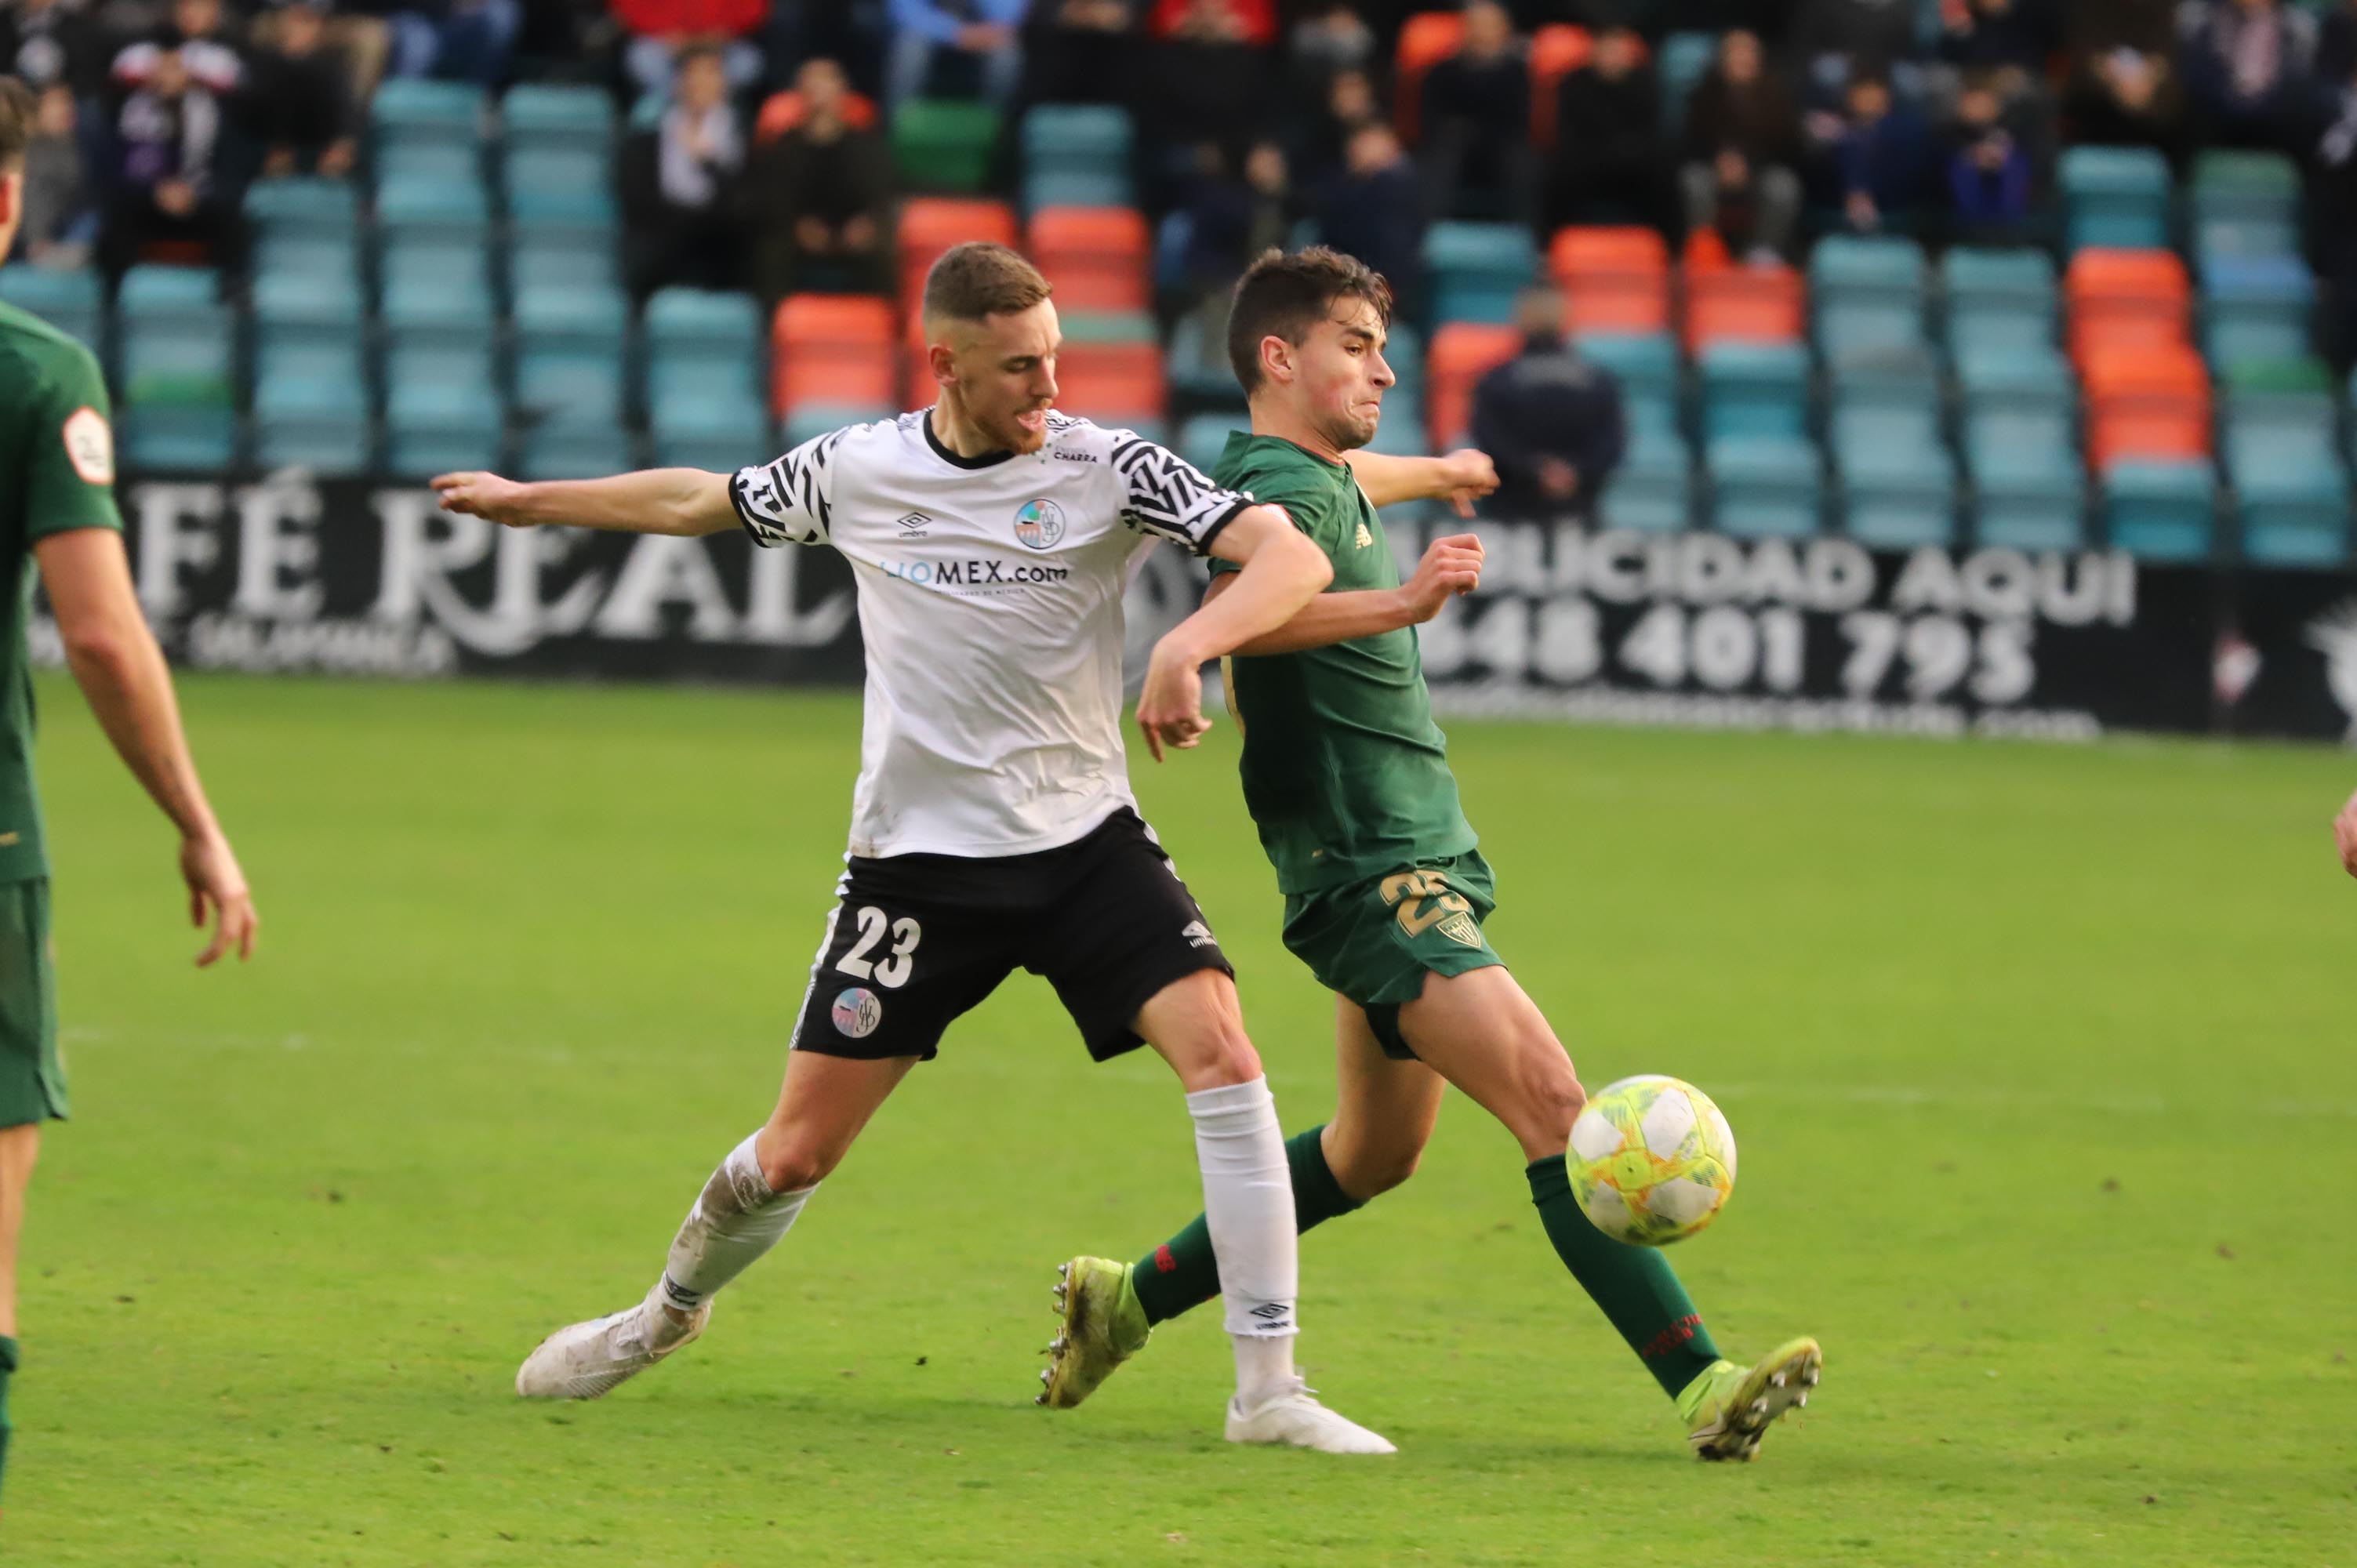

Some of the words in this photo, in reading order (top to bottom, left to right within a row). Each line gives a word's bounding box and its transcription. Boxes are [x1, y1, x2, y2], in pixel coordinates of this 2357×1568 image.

[367, 488, 855, 657] REAL
[1618, 601, 1806, 693] 401
[1837, 607, 2039, 705] 795
[835, 905, 922, 989] 23
